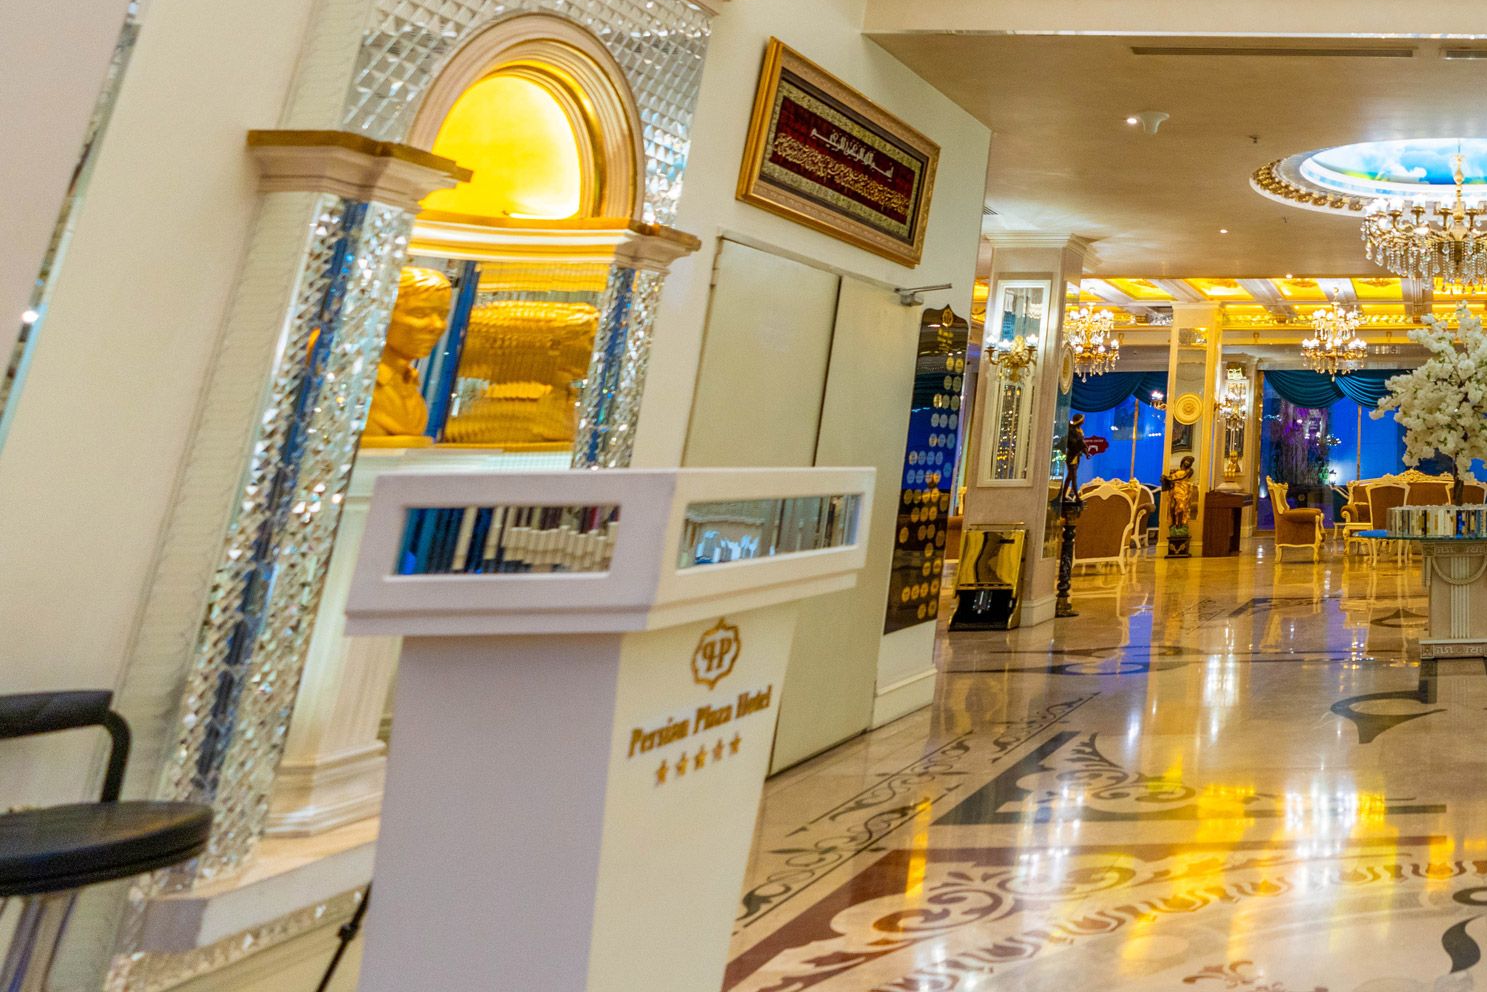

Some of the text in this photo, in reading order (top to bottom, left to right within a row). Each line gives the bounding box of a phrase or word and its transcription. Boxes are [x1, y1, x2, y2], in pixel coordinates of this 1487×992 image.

[628, 684, 772, 758] Persian Plaza Hotel
